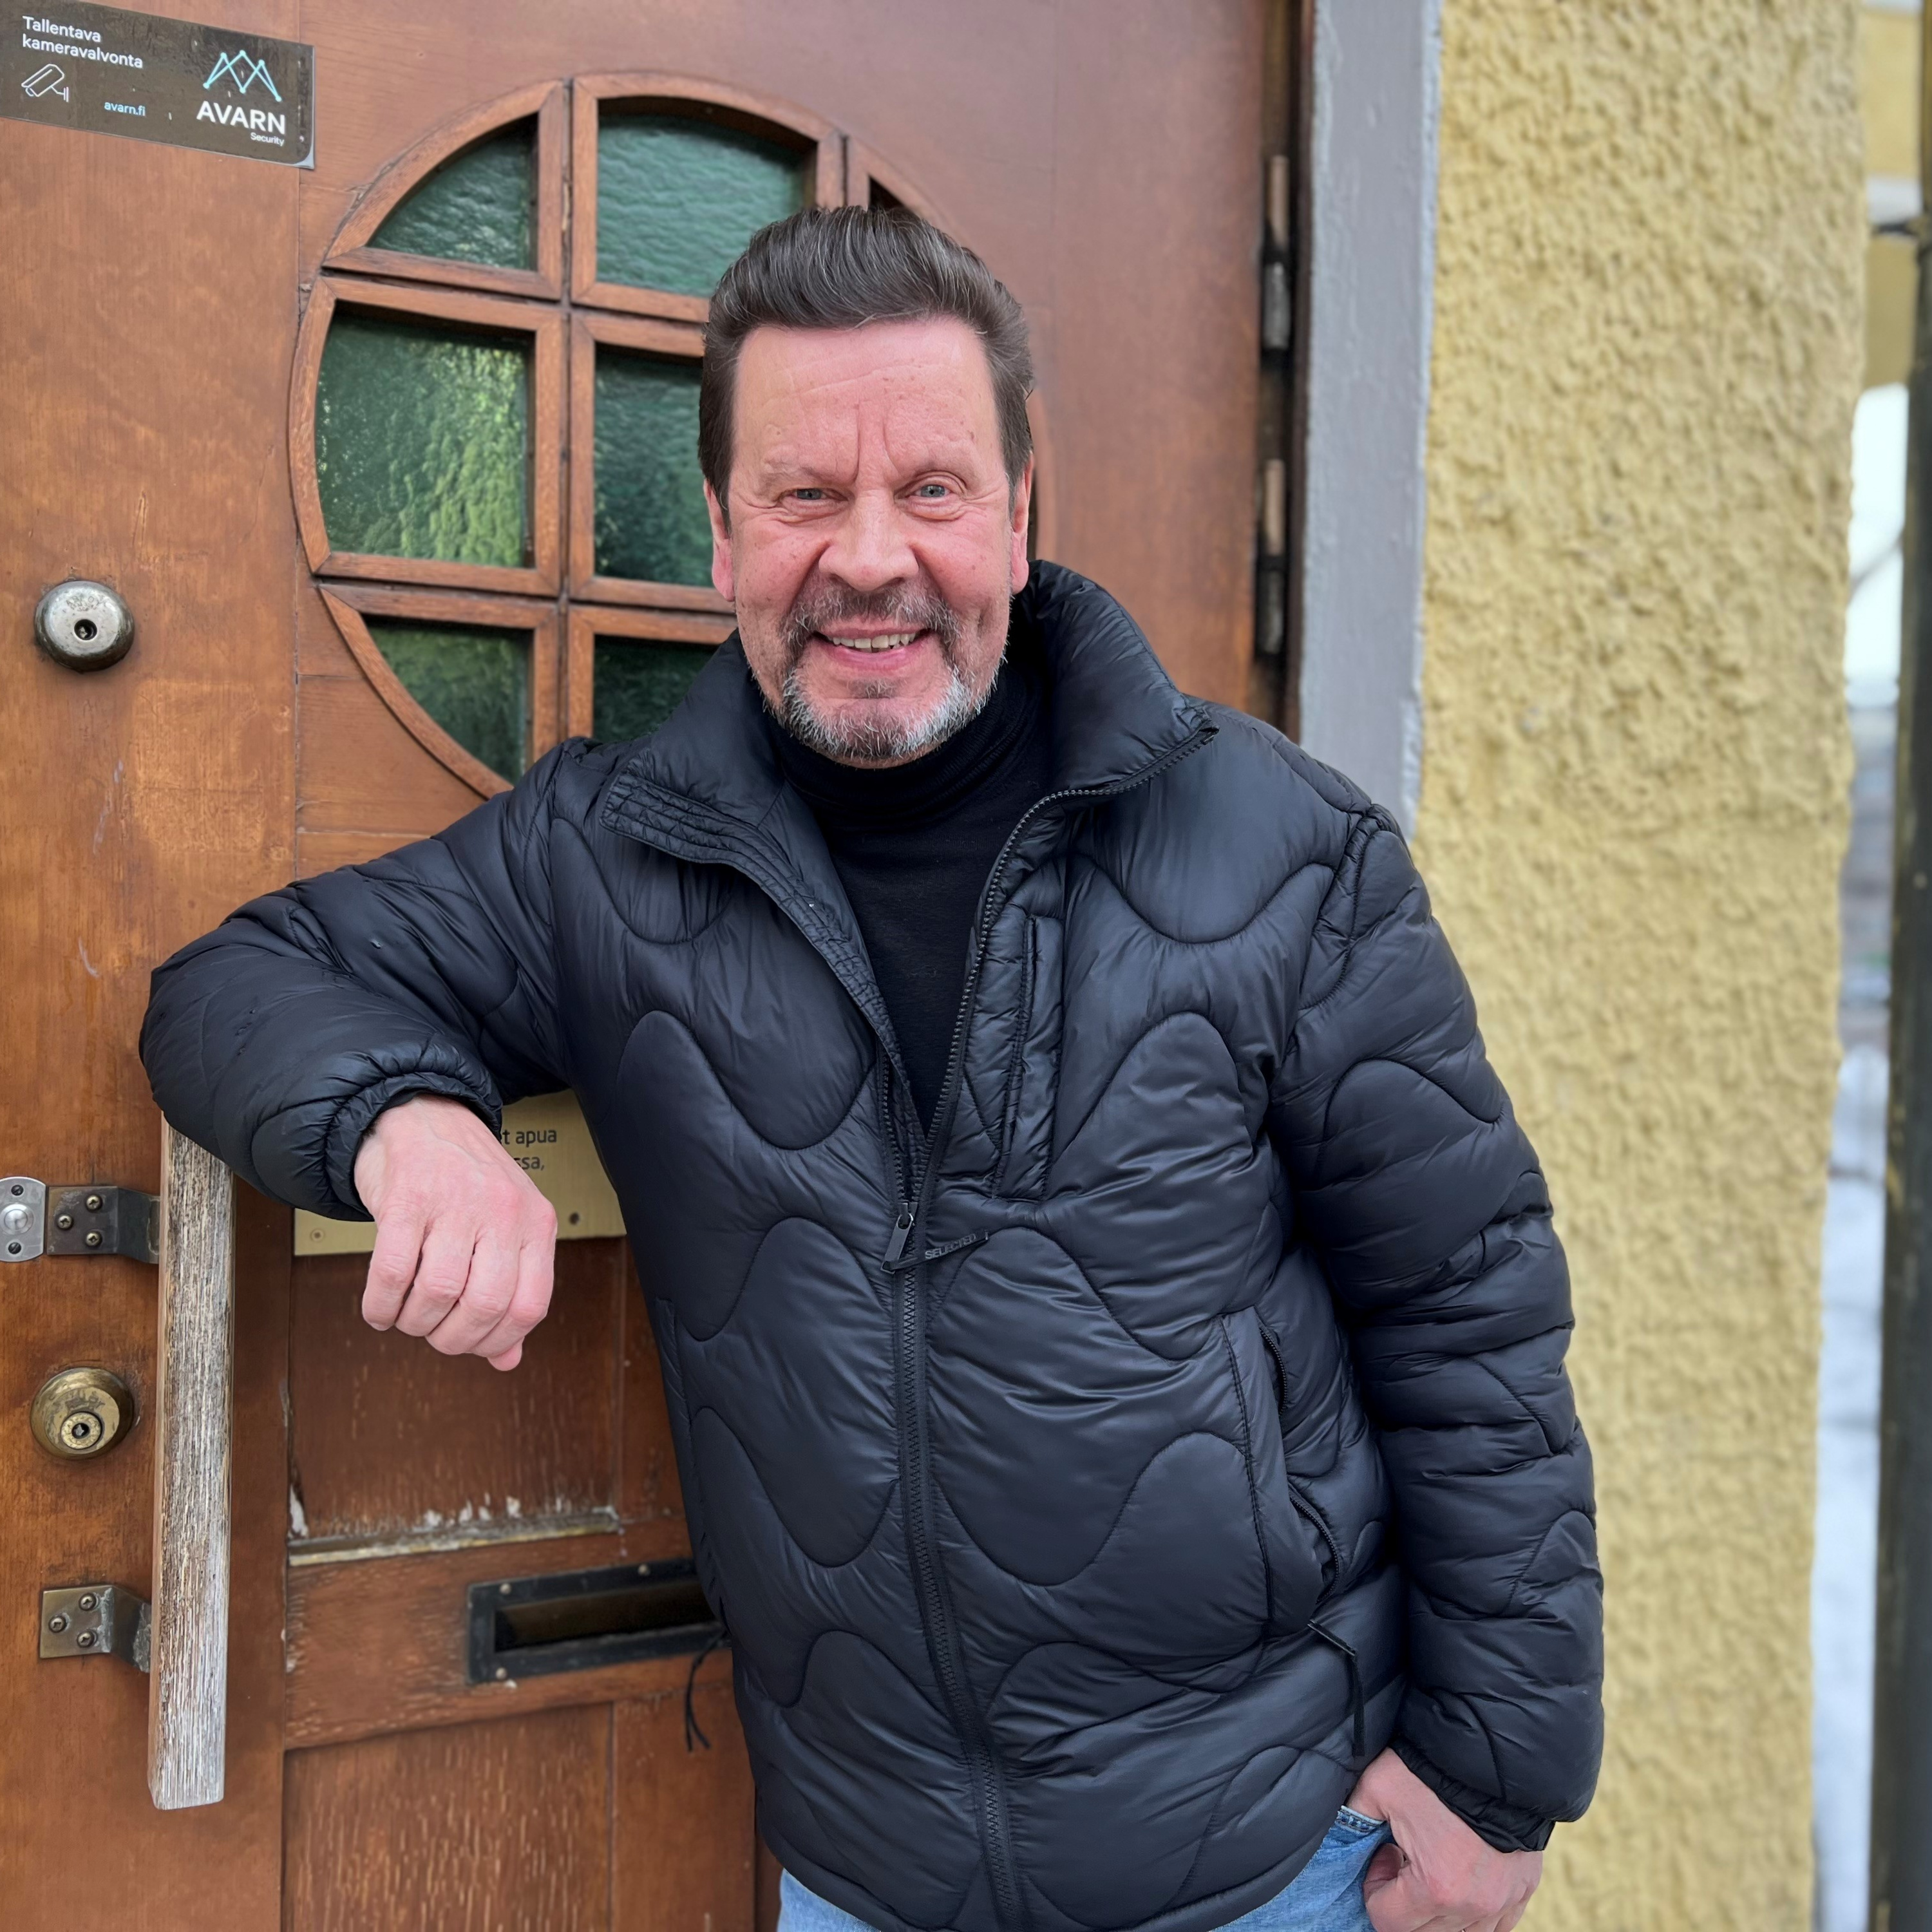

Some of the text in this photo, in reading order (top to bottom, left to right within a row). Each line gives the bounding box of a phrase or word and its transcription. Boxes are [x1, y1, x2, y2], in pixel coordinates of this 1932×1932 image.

[22, 15, 102, 43] Tallentava
[23, 33, 143, 68] kameravalvonta
[104, 102, 146, 117] avarn.fi
[196, 100, 285, 135] AVARN
[250, 131, 285, 147] Security
[515, 1129, 557, 1148] apua
[925, 1233, 976, 1260] SELECTED
